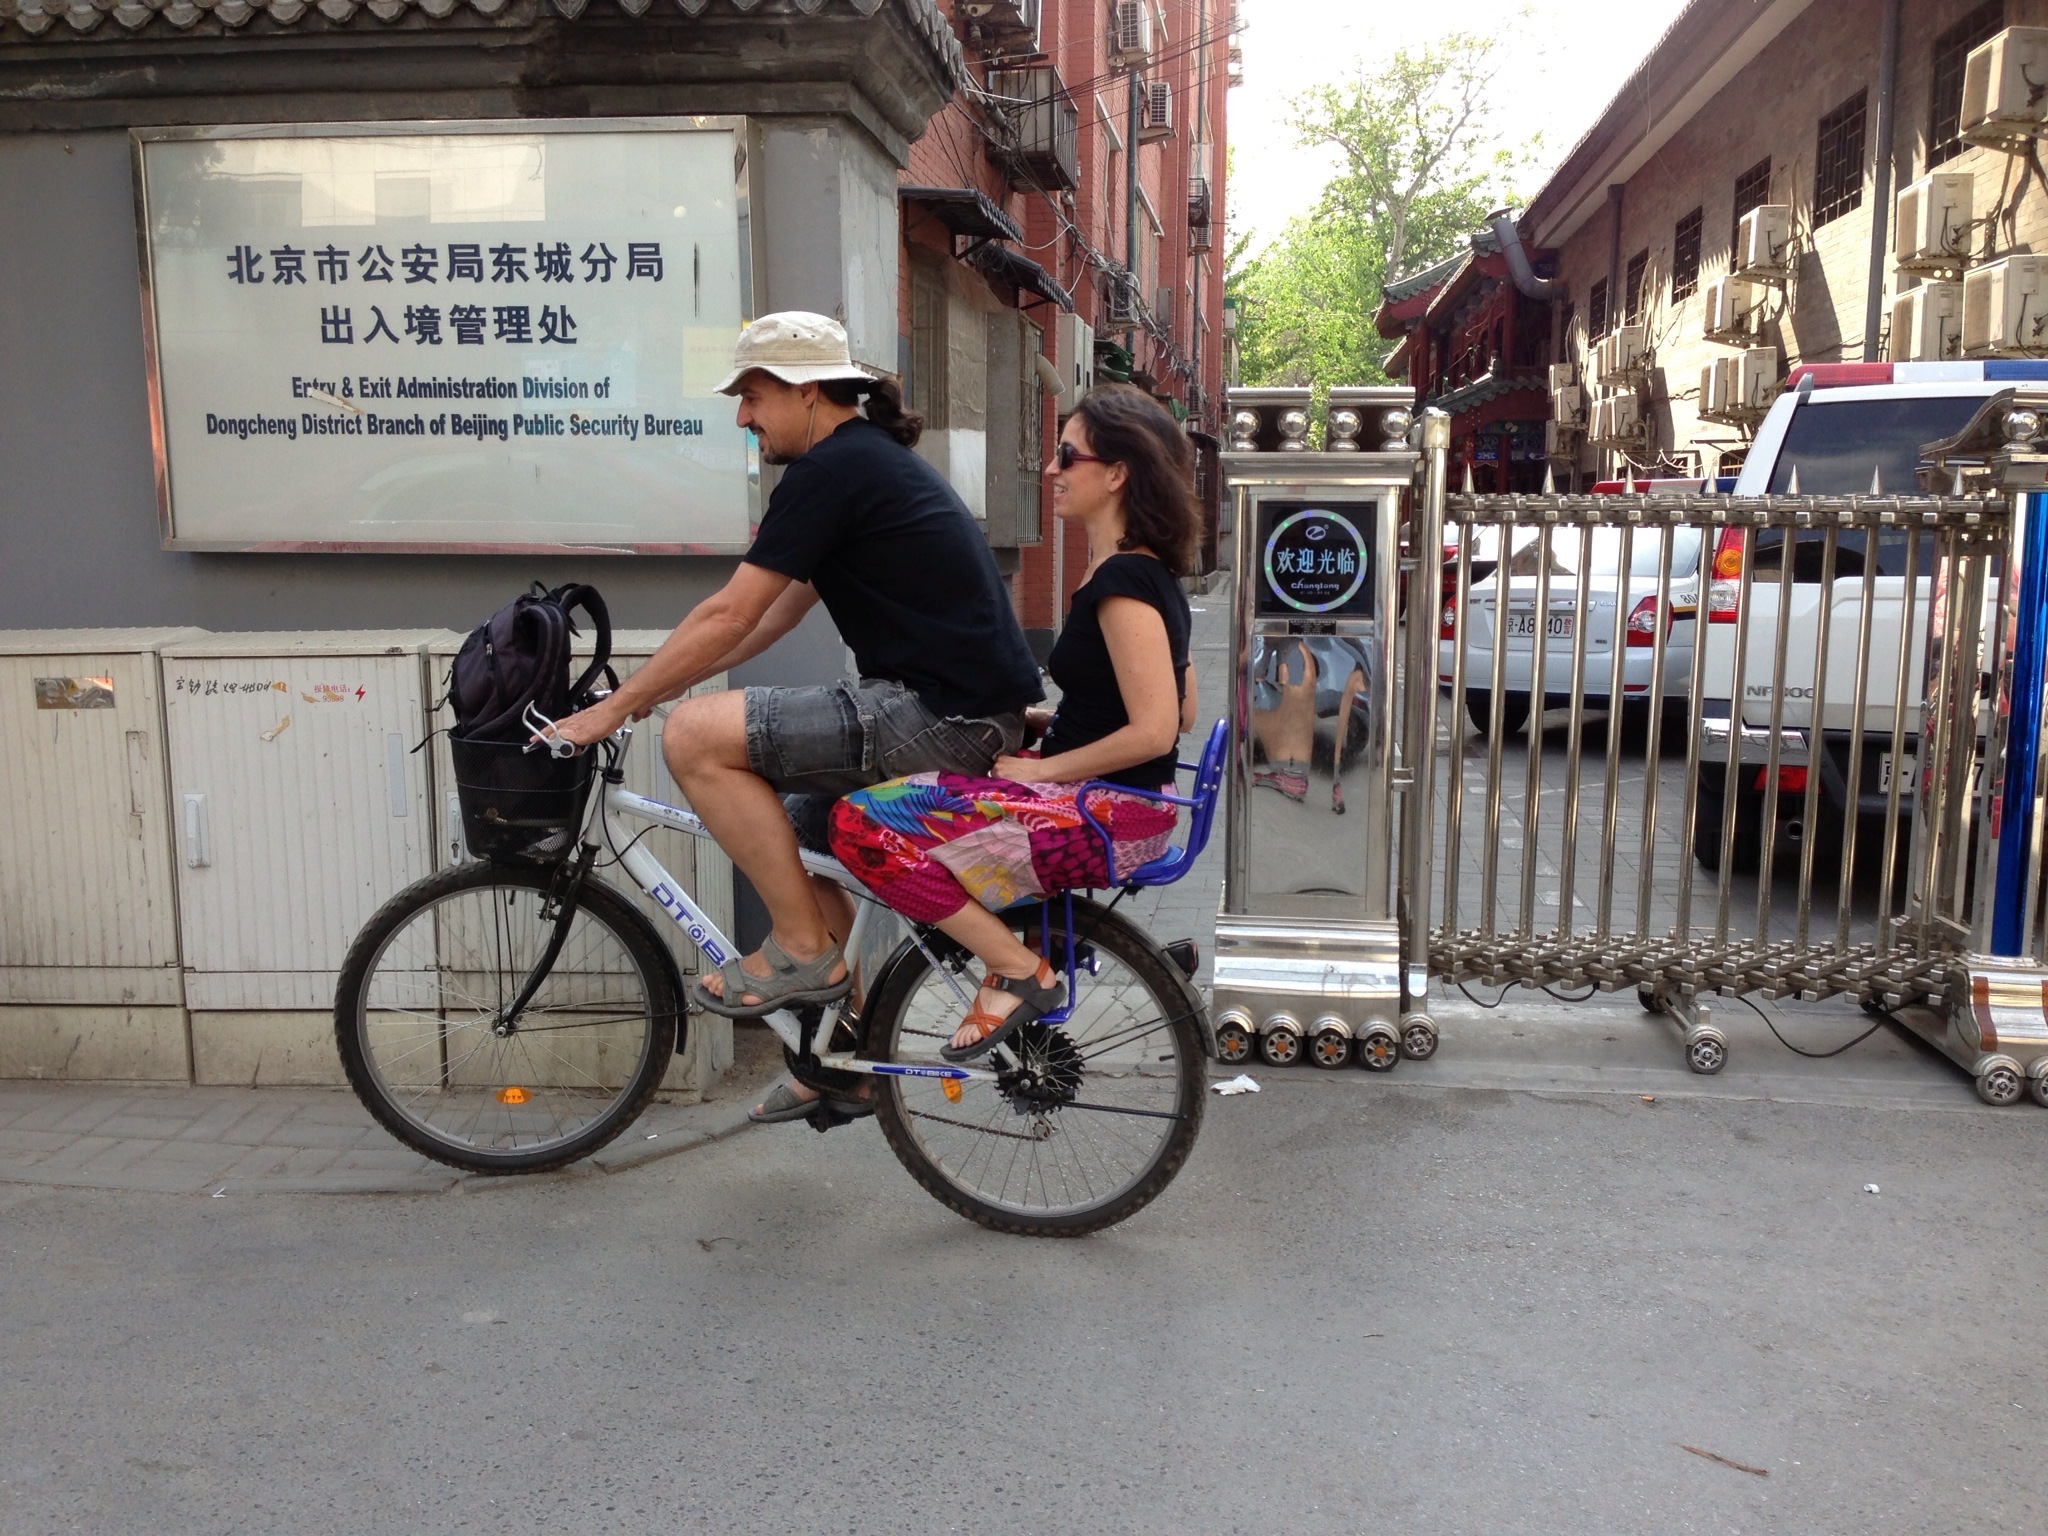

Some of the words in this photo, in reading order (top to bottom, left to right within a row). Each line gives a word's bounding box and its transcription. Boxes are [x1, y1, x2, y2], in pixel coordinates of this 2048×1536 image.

[226, 241, 664, 285] 北京市公安局东城分局
[320, 303, 578, 346] 出入境管理处
[292, 376, 336, 399] Entry
[341, 376, 354, 398] &
[359, 376, 392, 398] Exit
[397, 376, 517, 399] Administration
[522, 376, 589, 399] Division
[593, 376, 611, 399] of
[206, 413, 297, 440] Dongcheng
[302, 413, 363, 435] District
[367, 413, 425, 435] Branch
[430, 413, 446, 435] of
[451, 413, 509, 442] Beijing
[513, 413, 565, 436] Public
[569, 413, 640, 442] Security
[644, 413, 703, 436] Bureau
[1276, 547, 1356, 575] 欢迎光临
